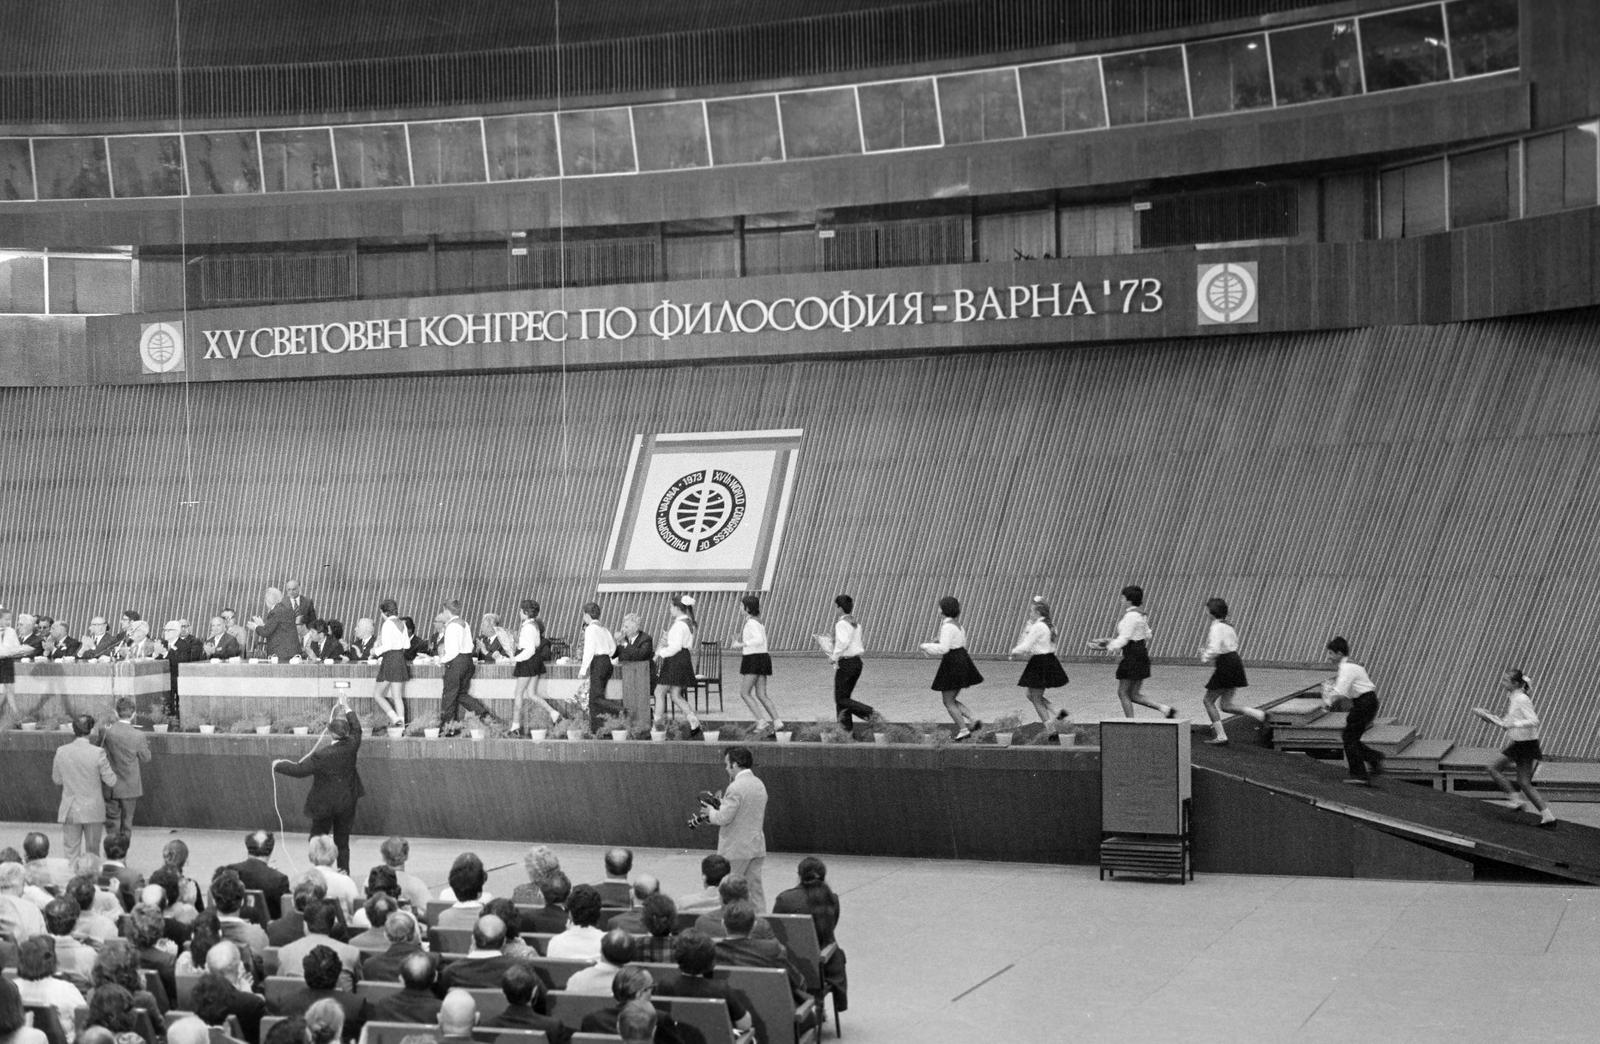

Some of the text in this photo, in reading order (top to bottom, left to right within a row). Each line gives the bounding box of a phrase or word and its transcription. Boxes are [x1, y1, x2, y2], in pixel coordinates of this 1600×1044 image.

[202, 329, 247, 360] XV
[250, 318, 409, 358] СВЕТОВЕН
[419, 311, 569, 347] КОНГРЕС
[580, 306, 637, 340] ПО
[649, 290, 924, 340] ФИЛОСОФИЯ
[682, 472, 703, 486] 1973
[728, 478, 745, 505] WORLD
[658, 486, 680, 513] VARNA
[657, 517, 689, 551] PHILOSOPHY
[713, 506, 745, 544] CONGRESS
[699, 540, 710, 551] OF
